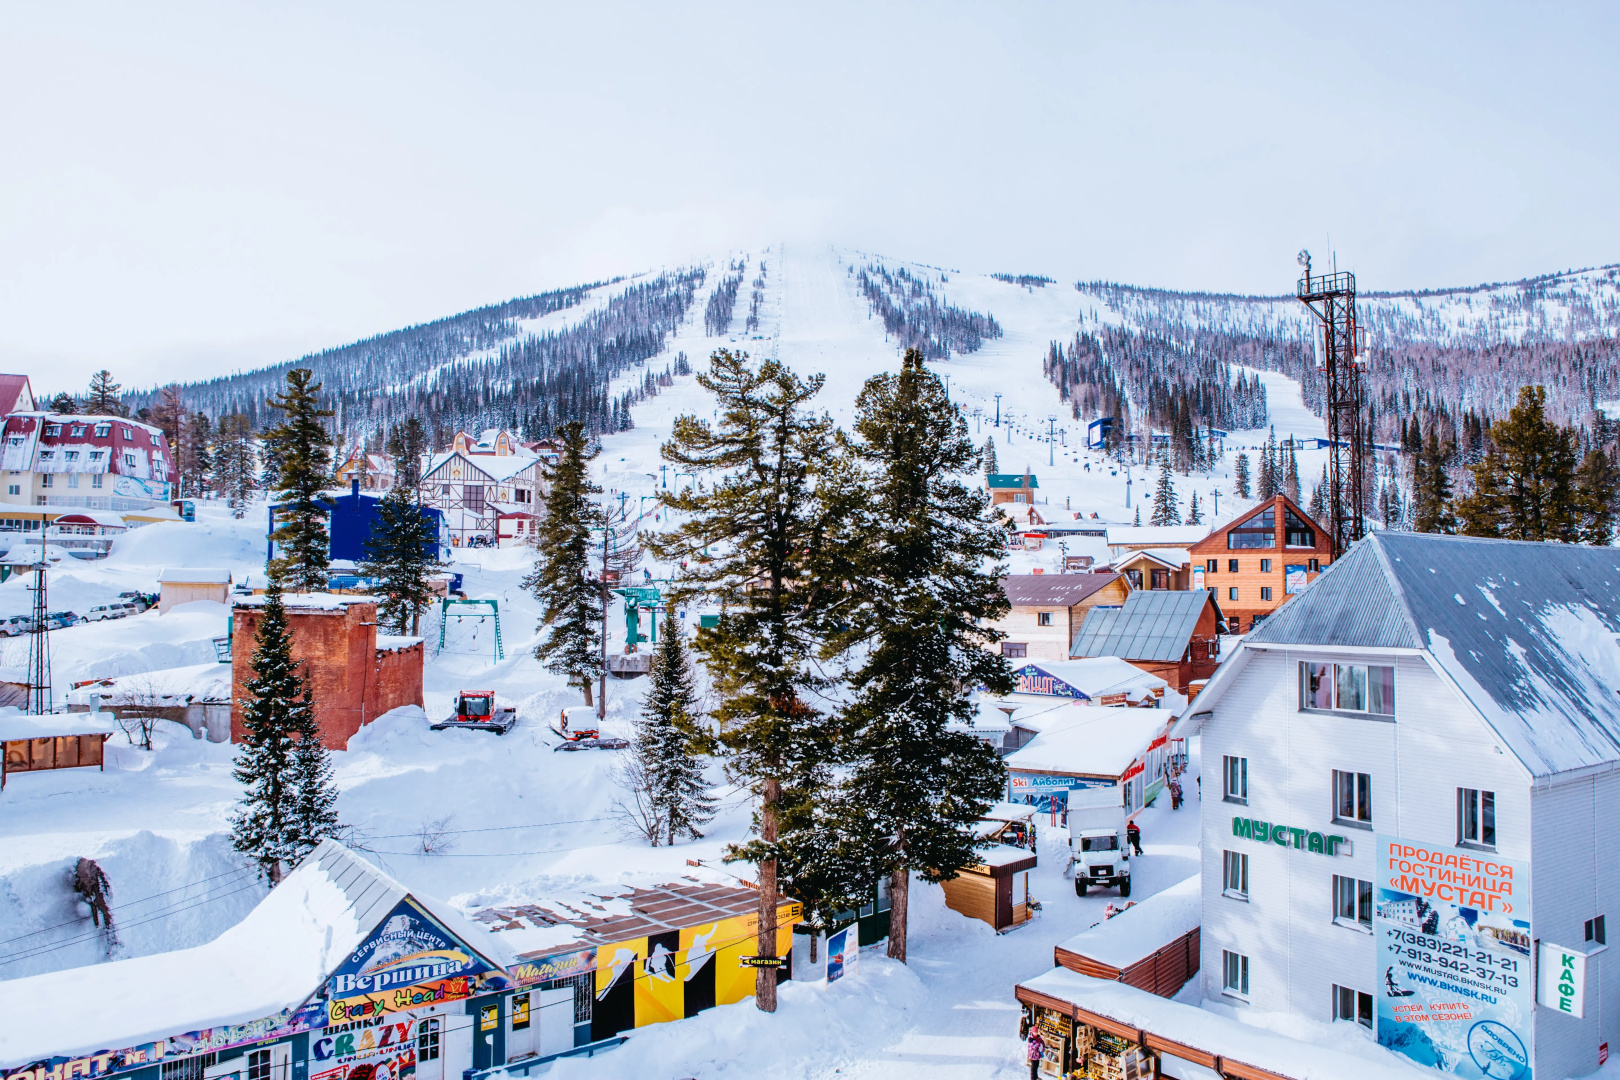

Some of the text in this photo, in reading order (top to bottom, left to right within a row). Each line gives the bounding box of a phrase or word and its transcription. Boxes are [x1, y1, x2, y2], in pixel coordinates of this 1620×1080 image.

[1012, 777, 1028, 787] Ski
[1031, 776, 1075, 787] Айболит
[1232, 816, 1344, 856] МУСТАГ
[1389, 843, 1513, 880] ПРОДАЁТСЯ
[1389, 858, 1512, 896] ГОСТИНИЦА
[1389, 874, 1514, 914] «МУСТАГ»
[351, 930, 446, 963] СЕРВИСНЫЙ ЦЕНТР
[1387, 929, 1518, 972] +7(383)221-21-21
[335, 960, 464, 994] Вершина
[514, 957, 577, 980] Магазин
[1387, 944, 1519, 988] +7-913-942-37-13
[1399, 959, 1507, 996] WWW.MUSTAG.BKNSK.RU
[1557, 953, 1575, 1013] КАФЕ
[331, 984, 445, 1020] Crazy Head
[1407, 972, 1497, 1005] WWW.BKNSK.RU
[1392, 1002, 1470, 1013] УСПЕЙ КУПИТЬ
[1403, 1014, 1430, 1022] ЭТОМ
[1431, 1013, 1473, 1021] СЕЗОНЕ!
[313, 1019, 415, 1061] CRAZY
[323, 1016, 384, 1037] ШАПКИ
[1481, 1024, 1525, 1063] ОДОБРЕНО
[0, 1051, 117, 1080] ОКАТ
[154, 1041, 164, 1059] 1
